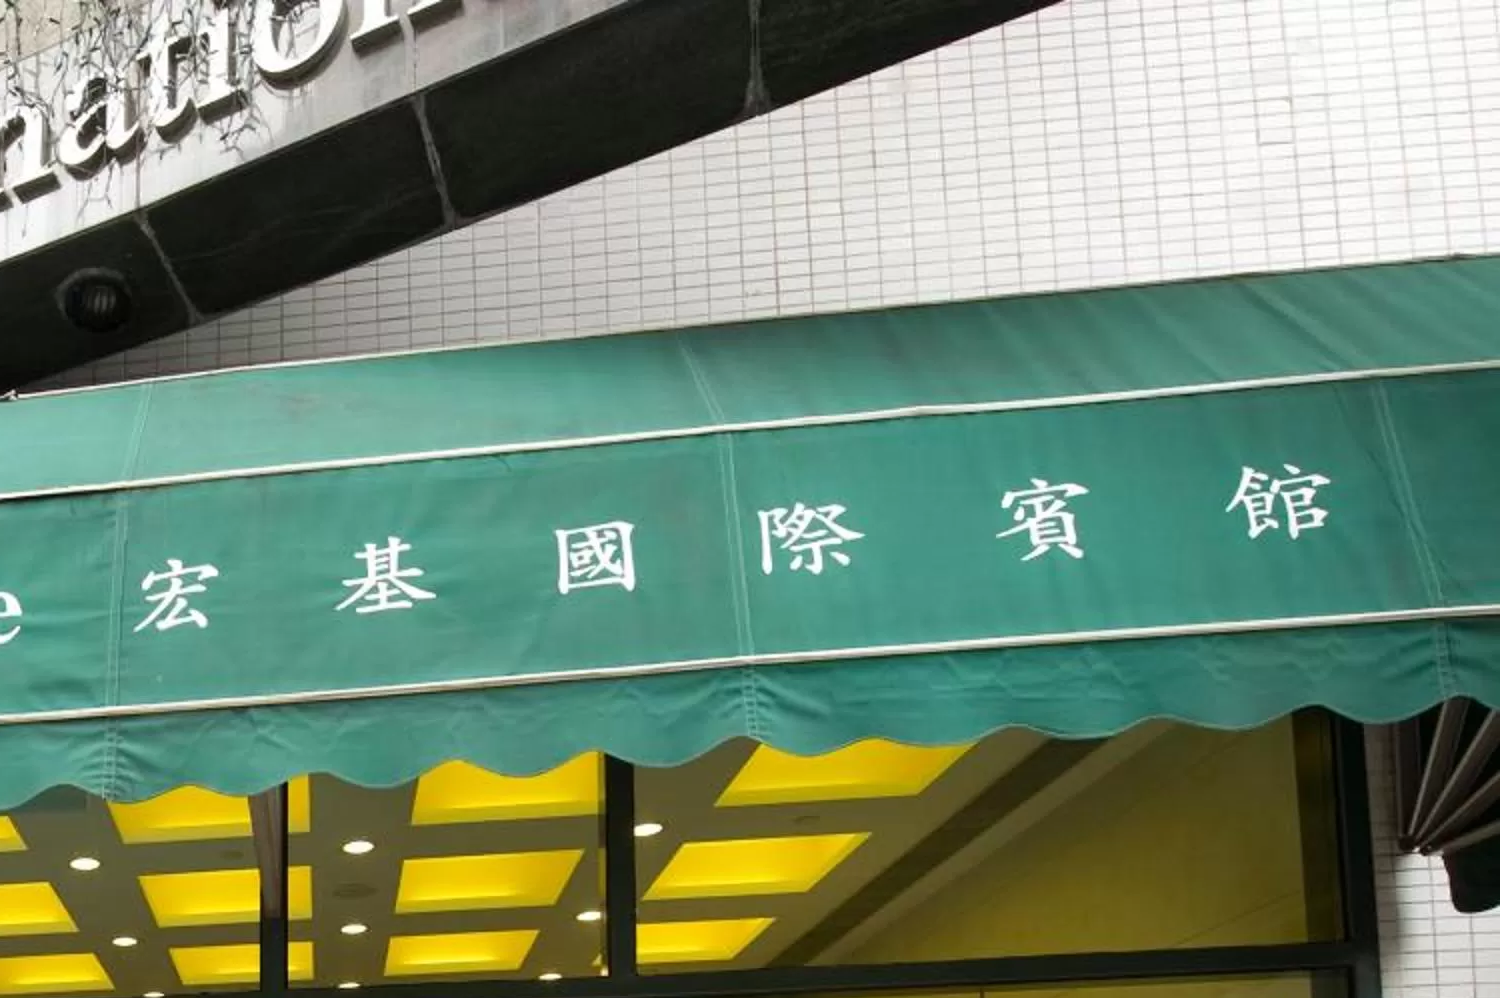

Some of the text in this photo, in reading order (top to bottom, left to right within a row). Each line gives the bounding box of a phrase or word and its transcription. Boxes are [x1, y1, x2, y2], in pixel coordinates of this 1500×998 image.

[133, 462, 1332, 634] 宏基國際賓館
